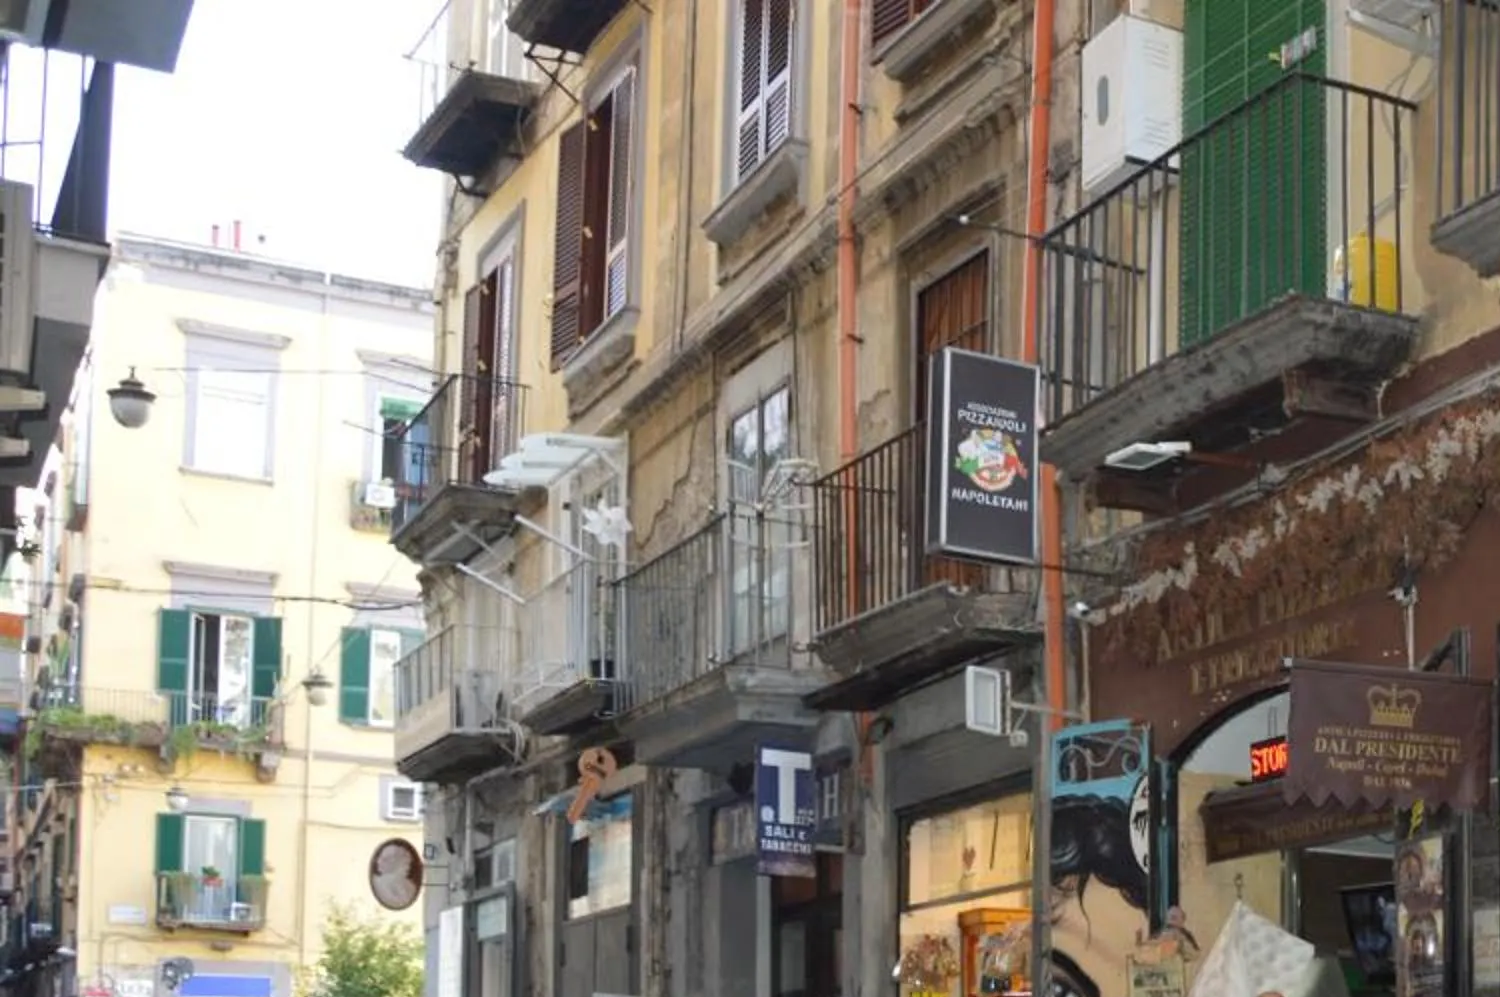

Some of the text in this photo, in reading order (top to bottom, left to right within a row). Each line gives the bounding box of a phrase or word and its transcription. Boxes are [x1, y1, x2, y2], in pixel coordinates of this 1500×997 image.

[952, 488, 1028, 512] NAPOLETANI
[1314, 737, 1463, 764] DAL PRESIDENTE
[765, 825, 795, 839] SALI
[761, 838, 812, 855] TABACCHI
